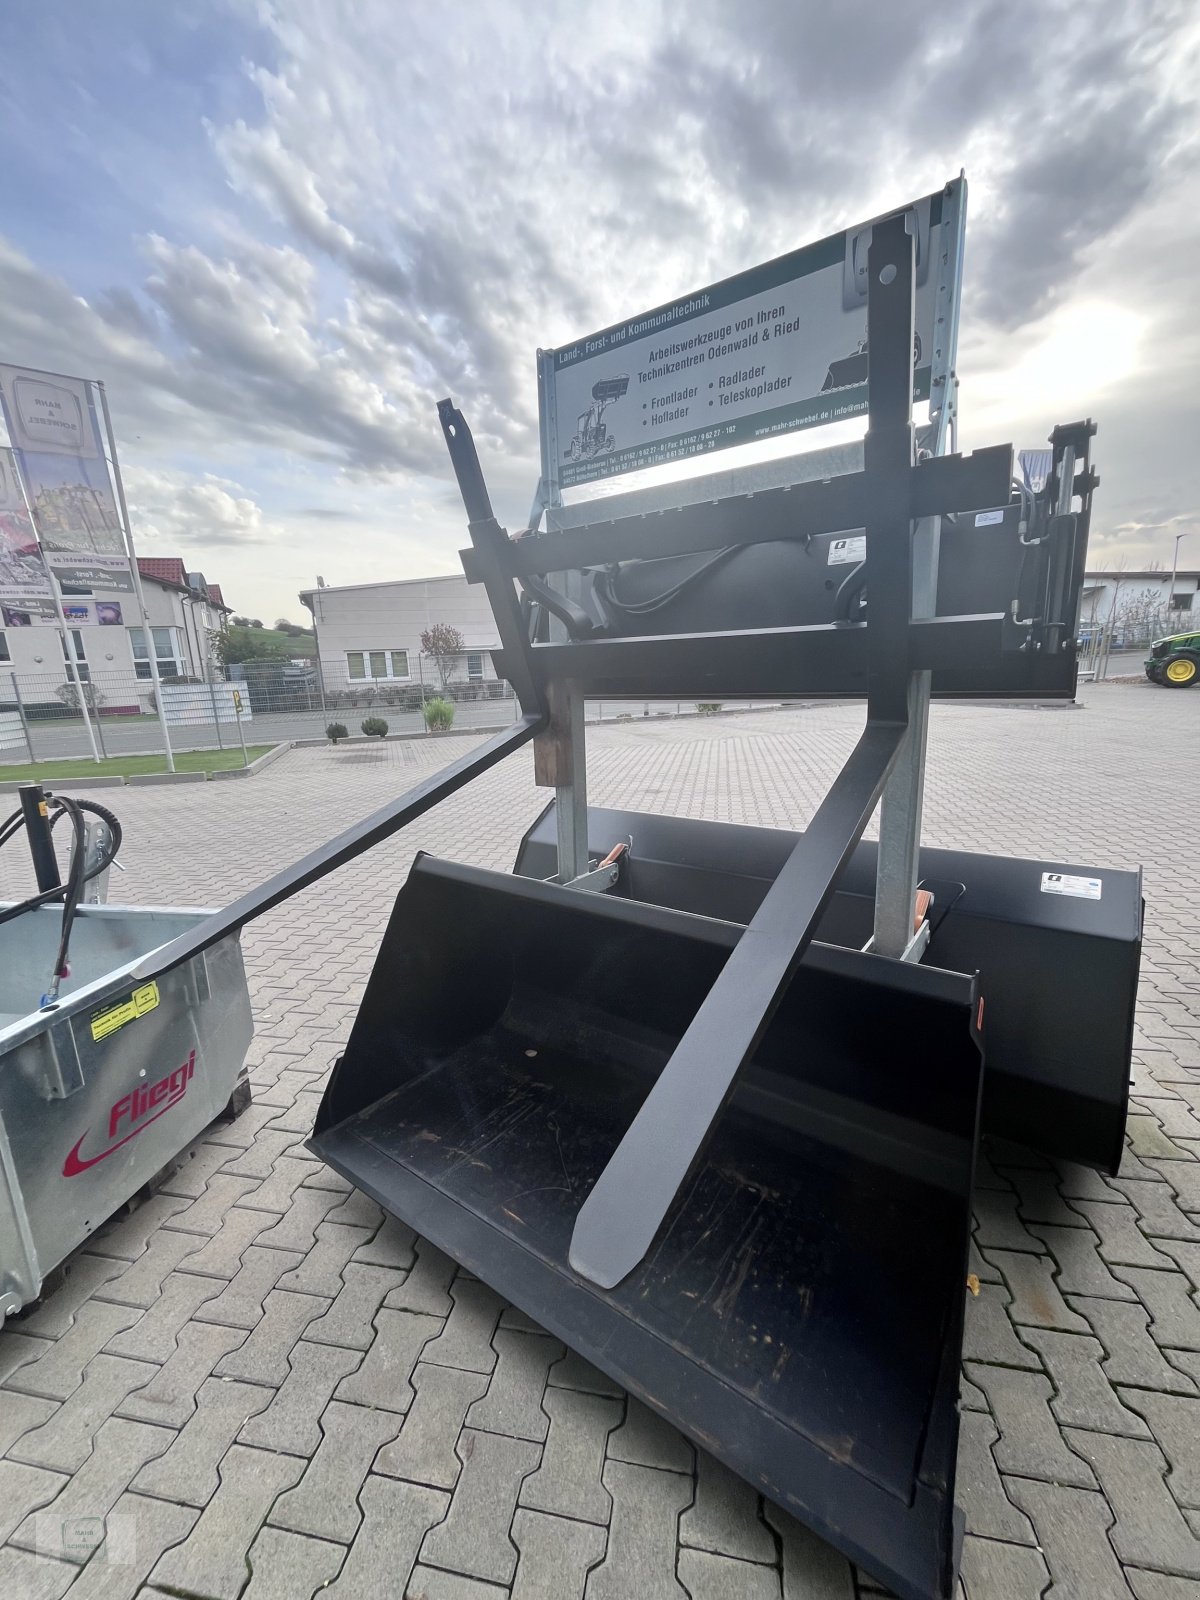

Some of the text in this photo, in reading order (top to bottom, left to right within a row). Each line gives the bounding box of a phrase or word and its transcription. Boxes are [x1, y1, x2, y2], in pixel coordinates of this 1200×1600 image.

[559, 294, 710, 364] Land-, Forst- und Kommunaltechnik
[648, 305, 785, 364] Arbeitswerkzeuge von Ihren
[637, 317, 800, 384] Technikzentren Odenwald & Ried
[718, 365, 766, 389] Radlader
[719, 376, 793, 406] Teleskoplader
[651, 386, 698, 410] Frontlader
[651, 406, 689, 426] Hoflader
